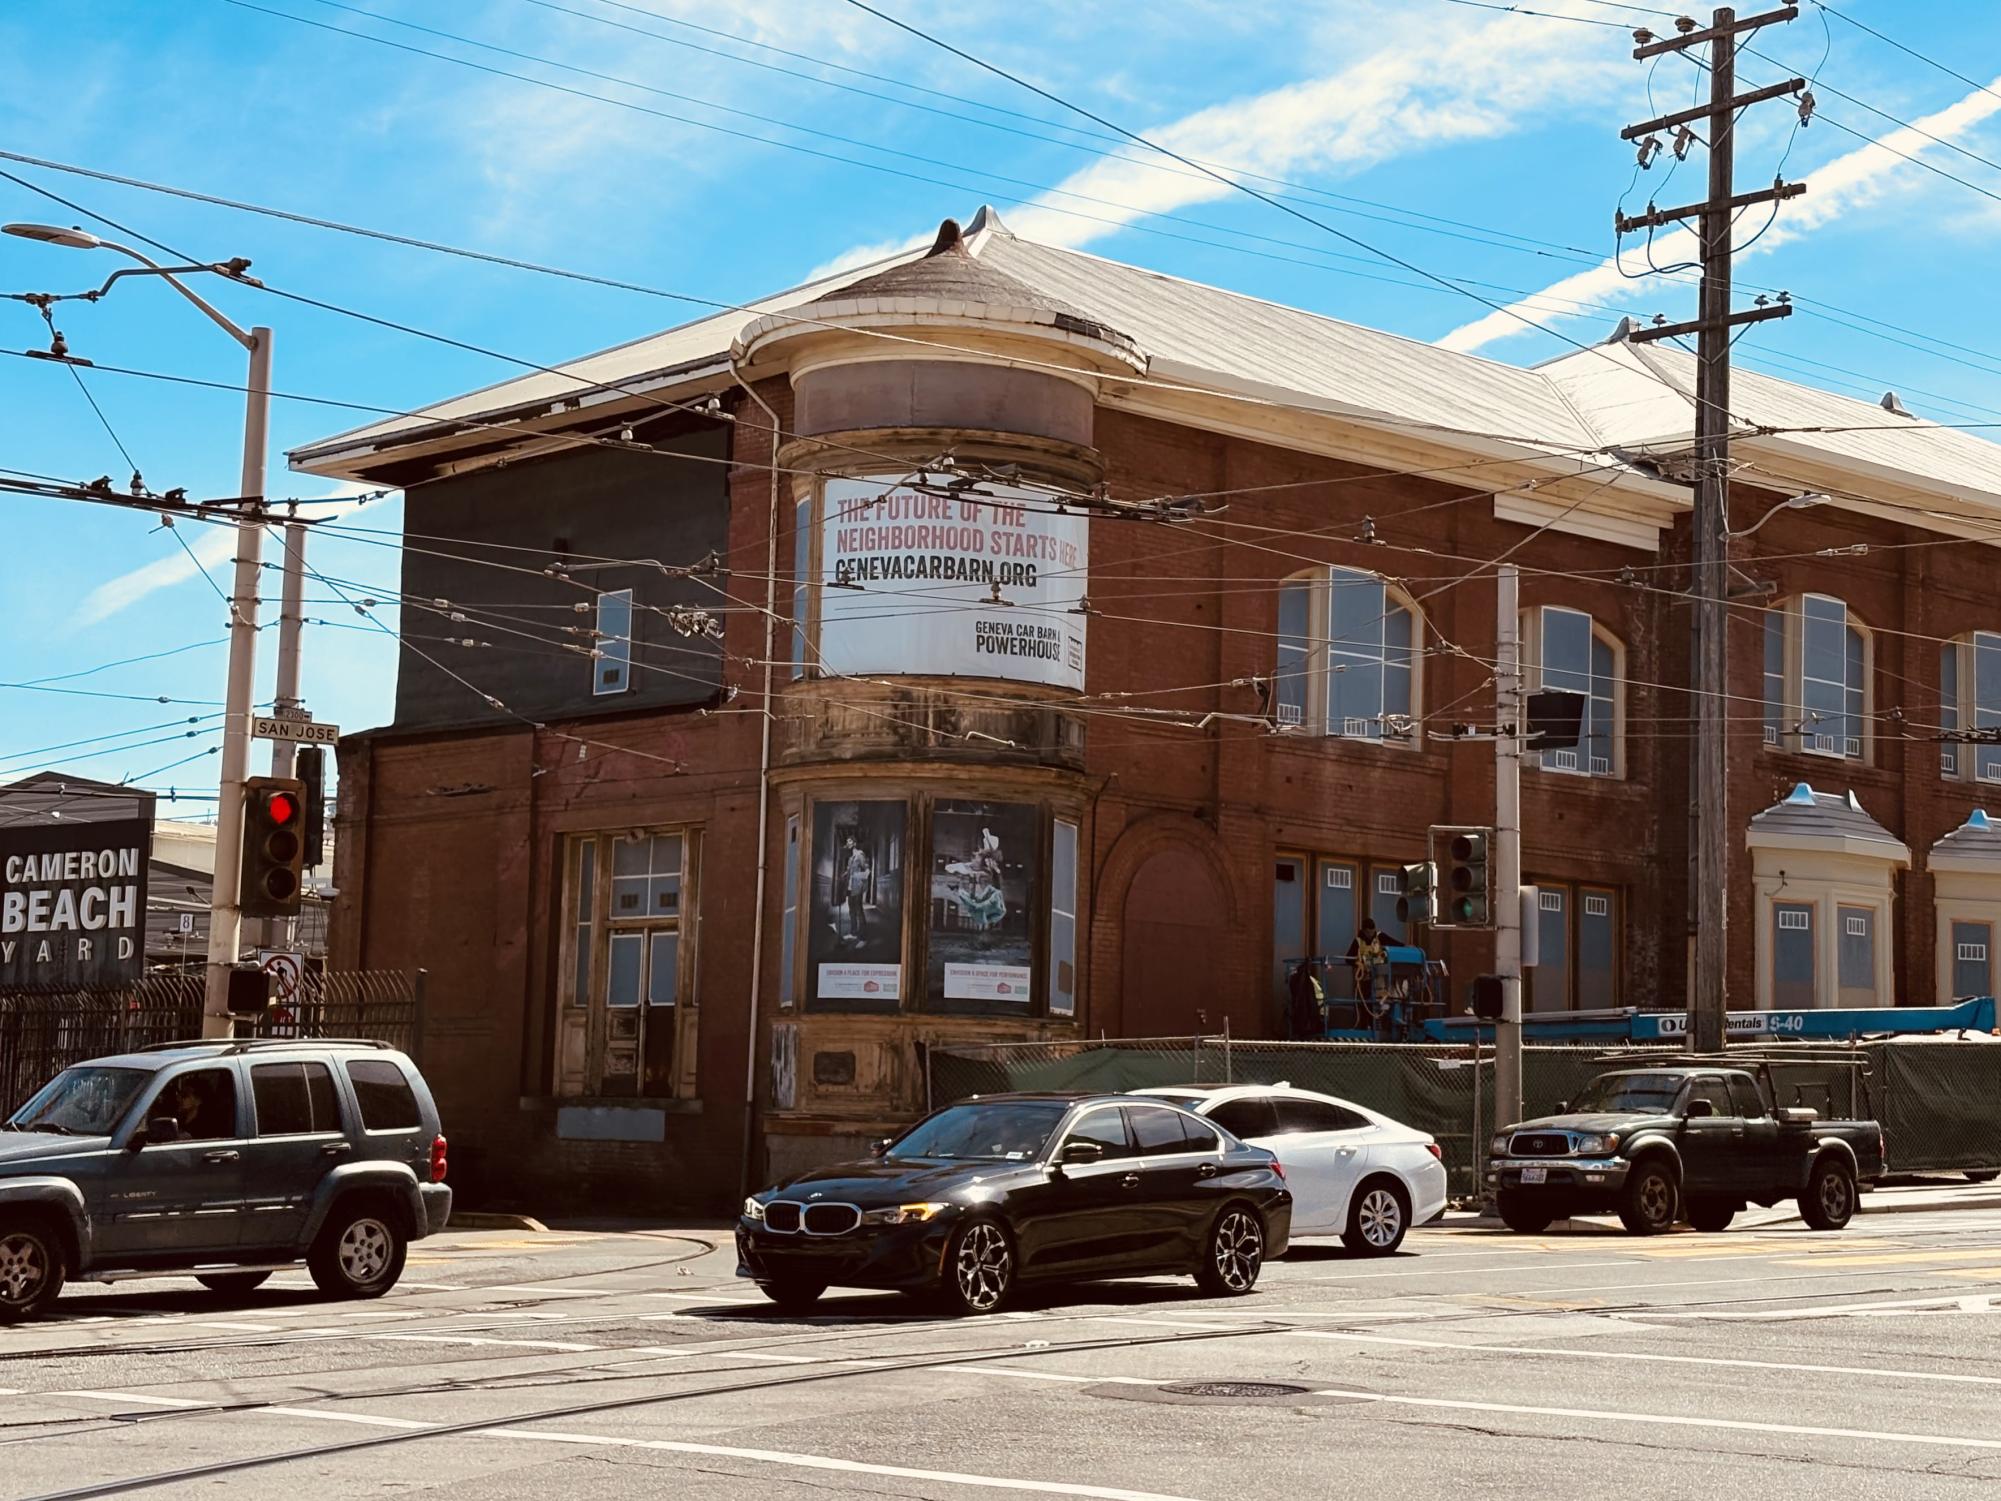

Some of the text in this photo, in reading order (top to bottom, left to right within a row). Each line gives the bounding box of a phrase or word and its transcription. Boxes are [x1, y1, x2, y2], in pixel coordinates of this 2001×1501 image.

[837, 496, 1026, 528] THE FUTURE OF THE
[837, 525, 984, 554] NEIGHBORHOOD
[990, 529, 1057, 561] STARTS
[835, 555, 1037, 587] GENEVACARBARN.ORG
[975, 620, 1014, 636] GENEVA
[1016, 624, 1035, 638] CAR
[1037, 626, 1057, 641] BARN
[258, 721, 335, 741] SAN JOSE
[5, 848, 139, 884] CAMERON
[2, 885, 138, 933] BEACH
[182, 915, 191, 929] 8
[1, 936, 135, 964] YARD
[1769, 1015, 1804, 1031] S-40
